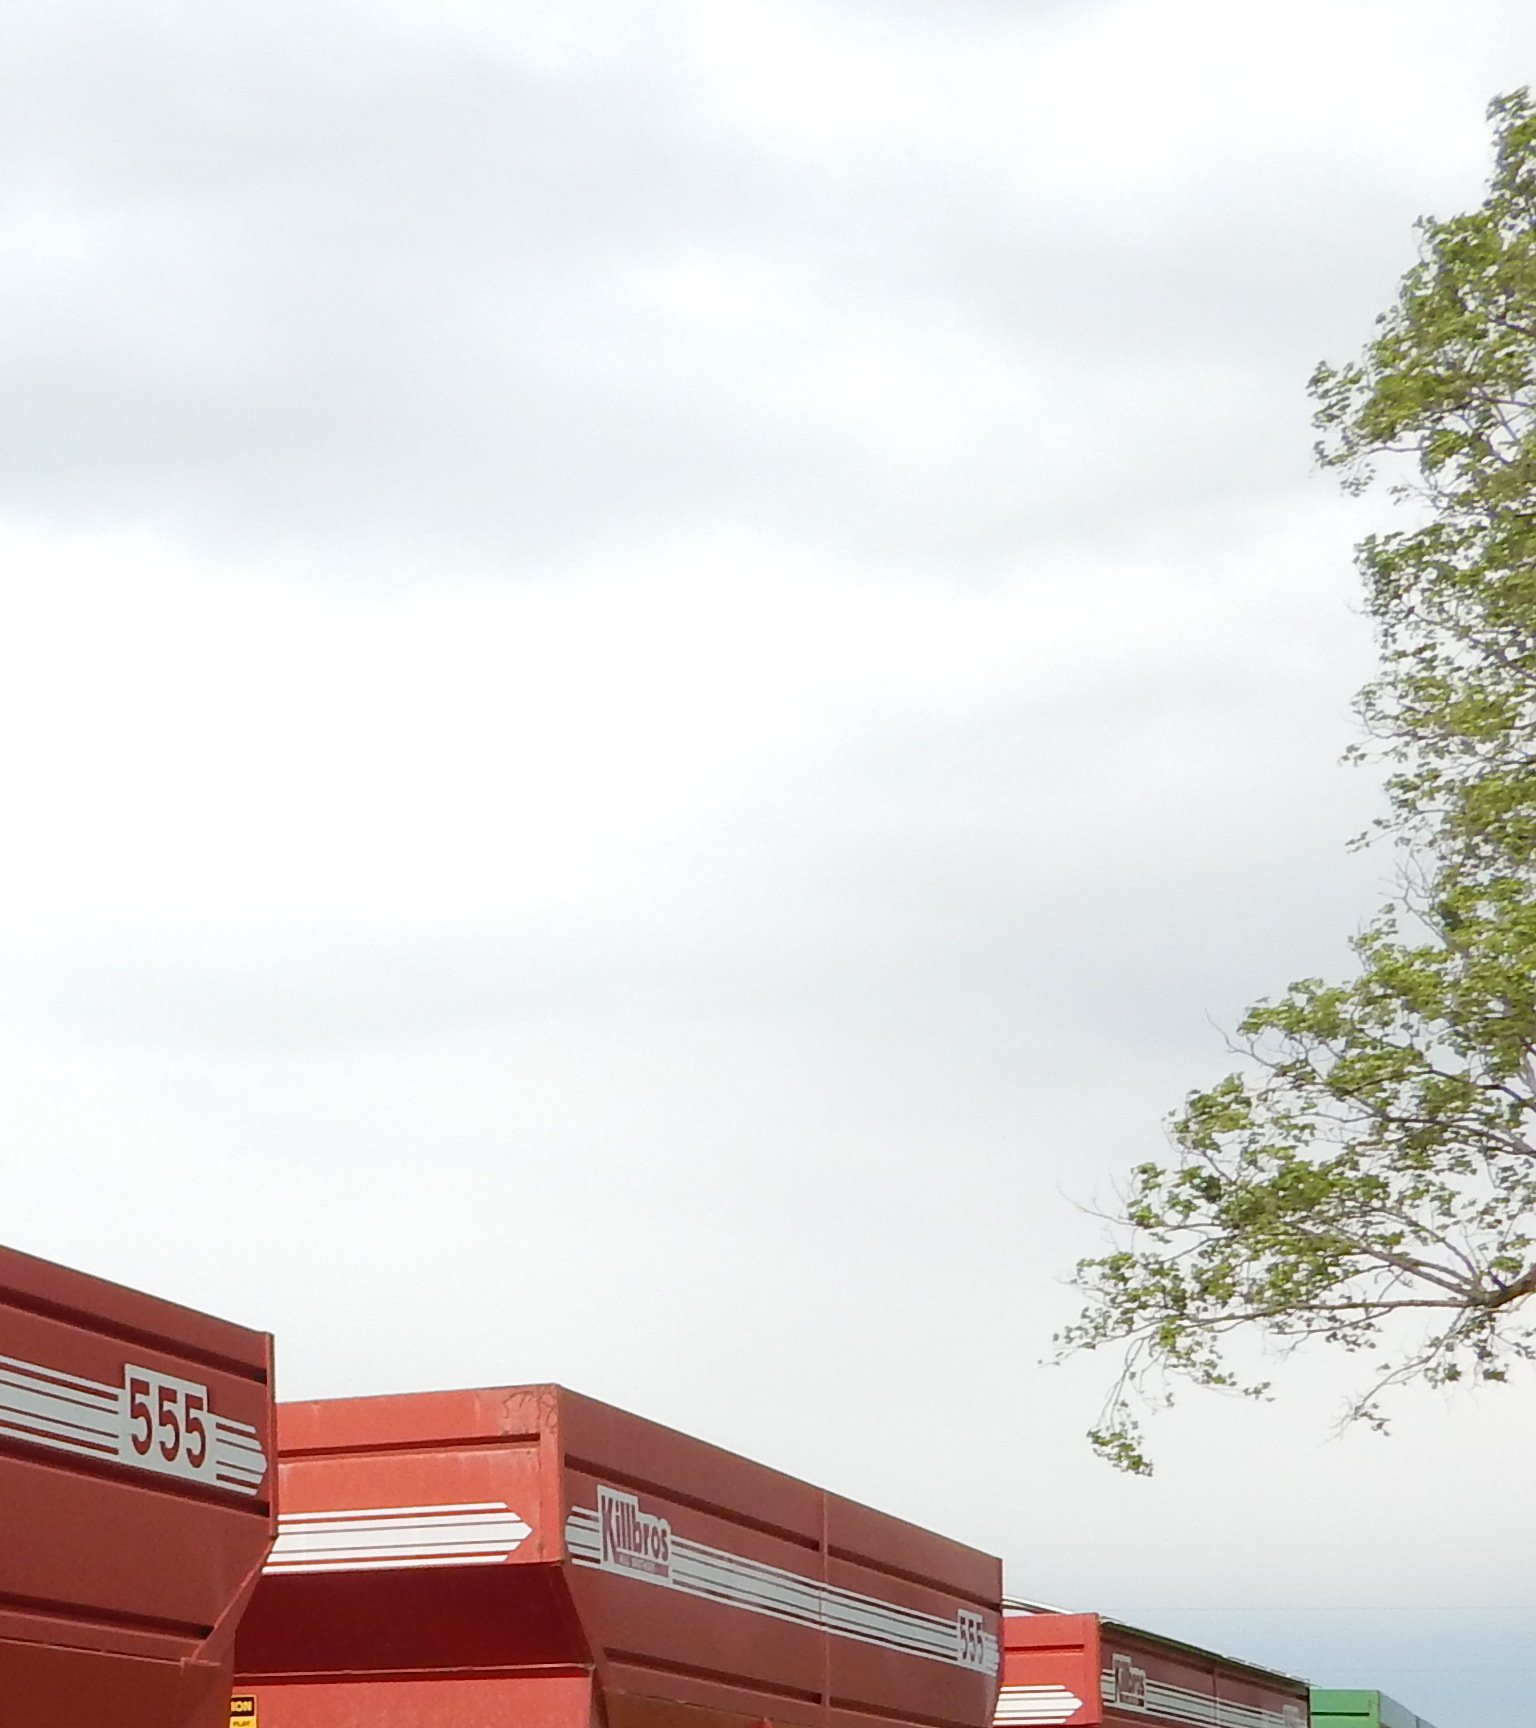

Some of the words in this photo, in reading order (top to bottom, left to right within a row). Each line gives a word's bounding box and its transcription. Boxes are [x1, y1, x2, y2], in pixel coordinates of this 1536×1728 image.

[130, 1377, 207, 1468] 555
[601, 1494, 669, 1561] Killbros
[960, 1616, 984, 1665] 555
